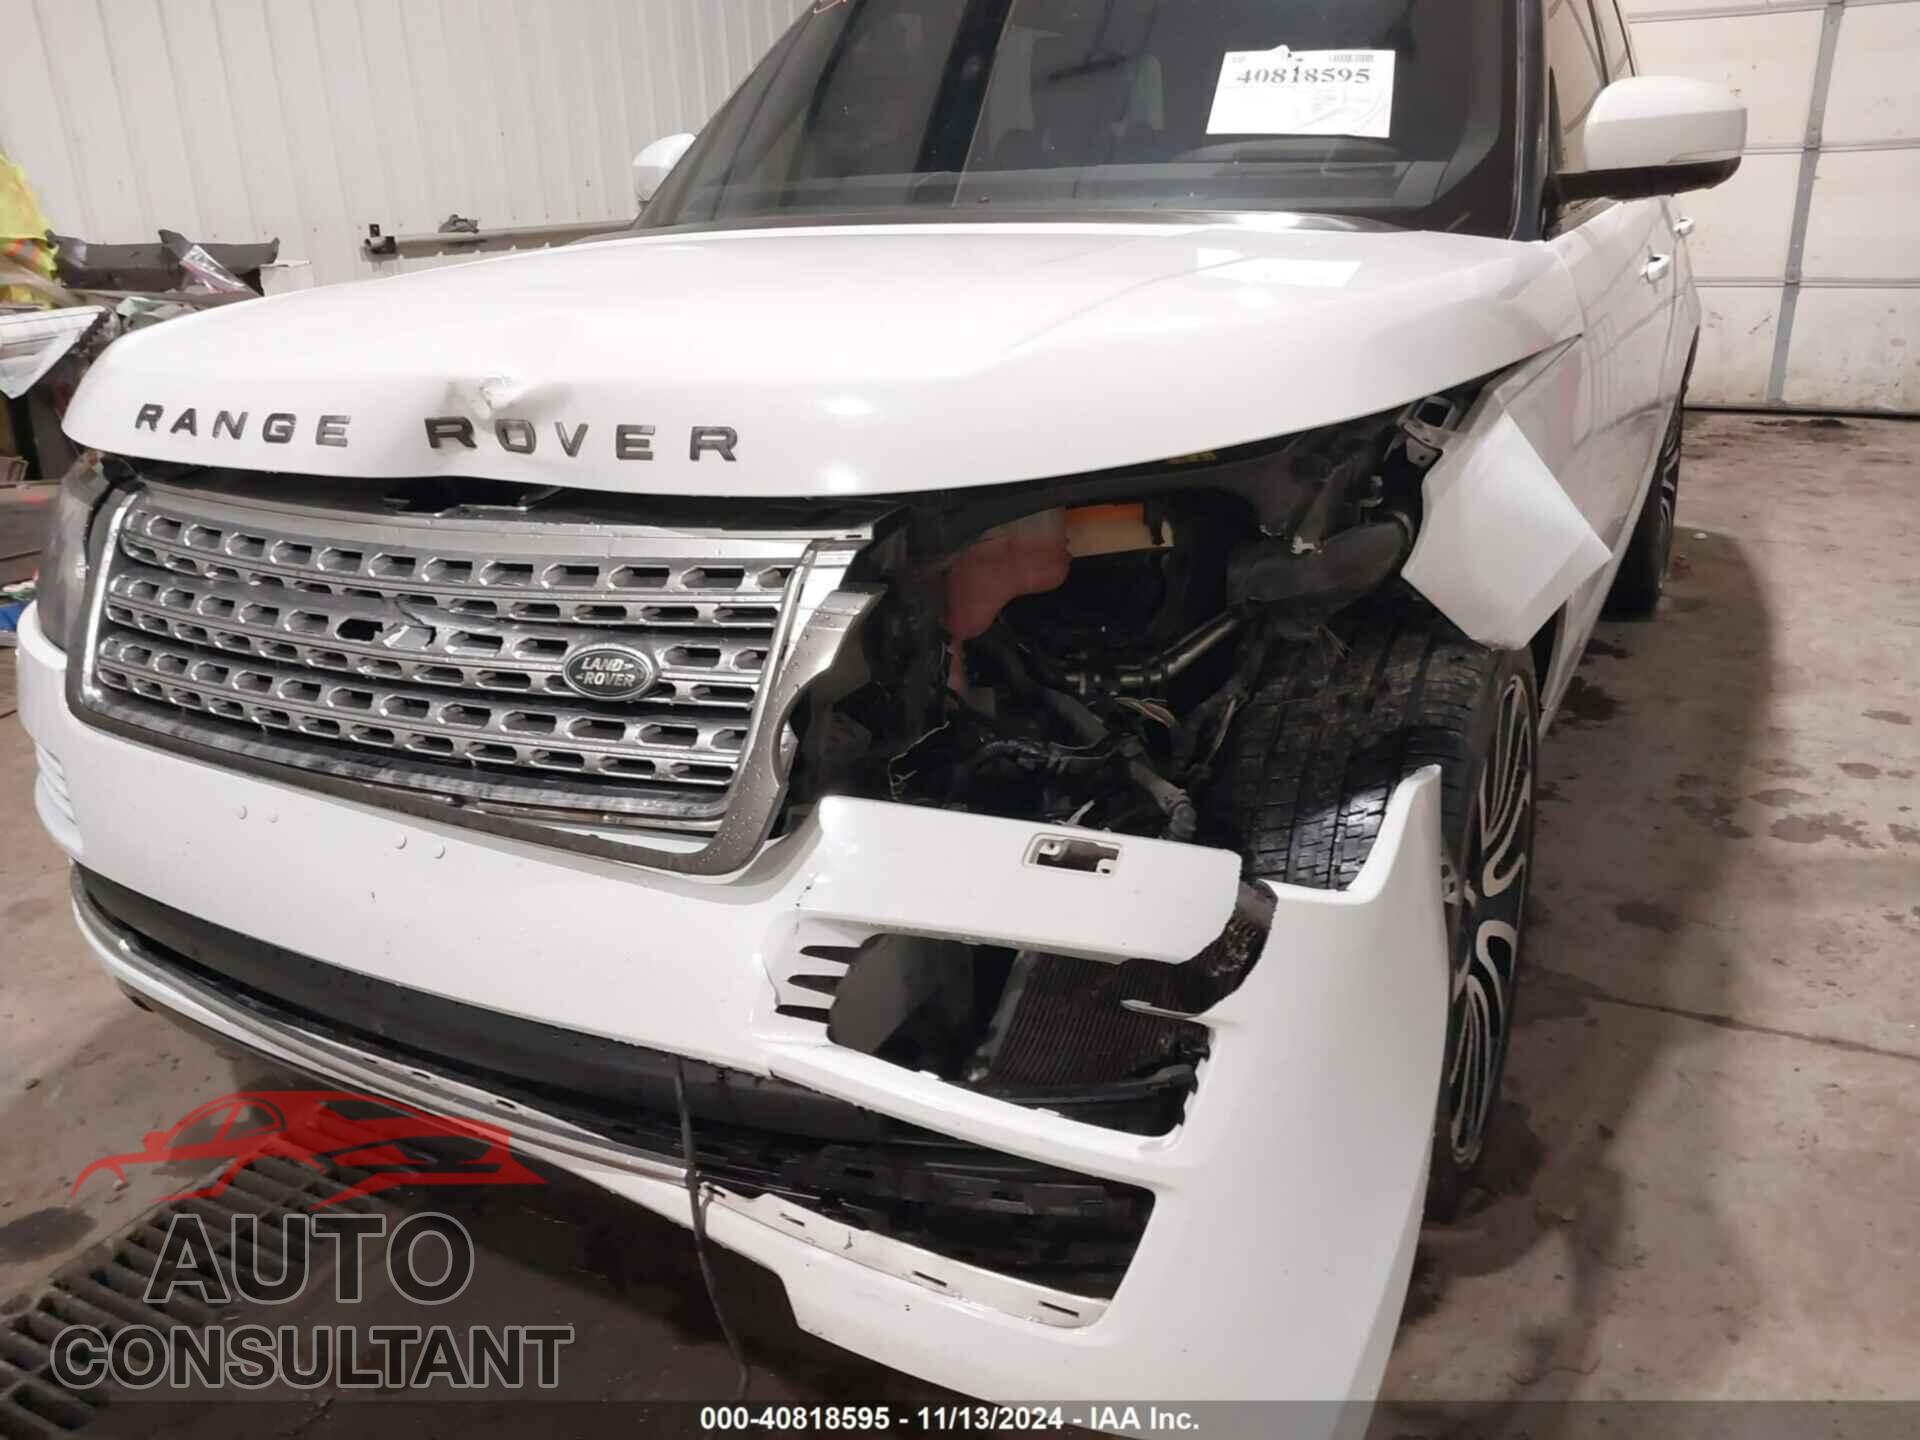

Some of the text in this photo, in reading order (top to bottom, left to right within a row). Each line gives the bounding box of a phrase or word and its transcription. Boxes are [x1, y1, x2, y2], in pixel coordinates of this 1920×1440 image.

[1236, 66, 1372, 84] 40818595
[135, 403, 738, 462] RANGE ROVER
[582, 657, 624, 672] LAND
[583, 671, 636, 687] ROVER
